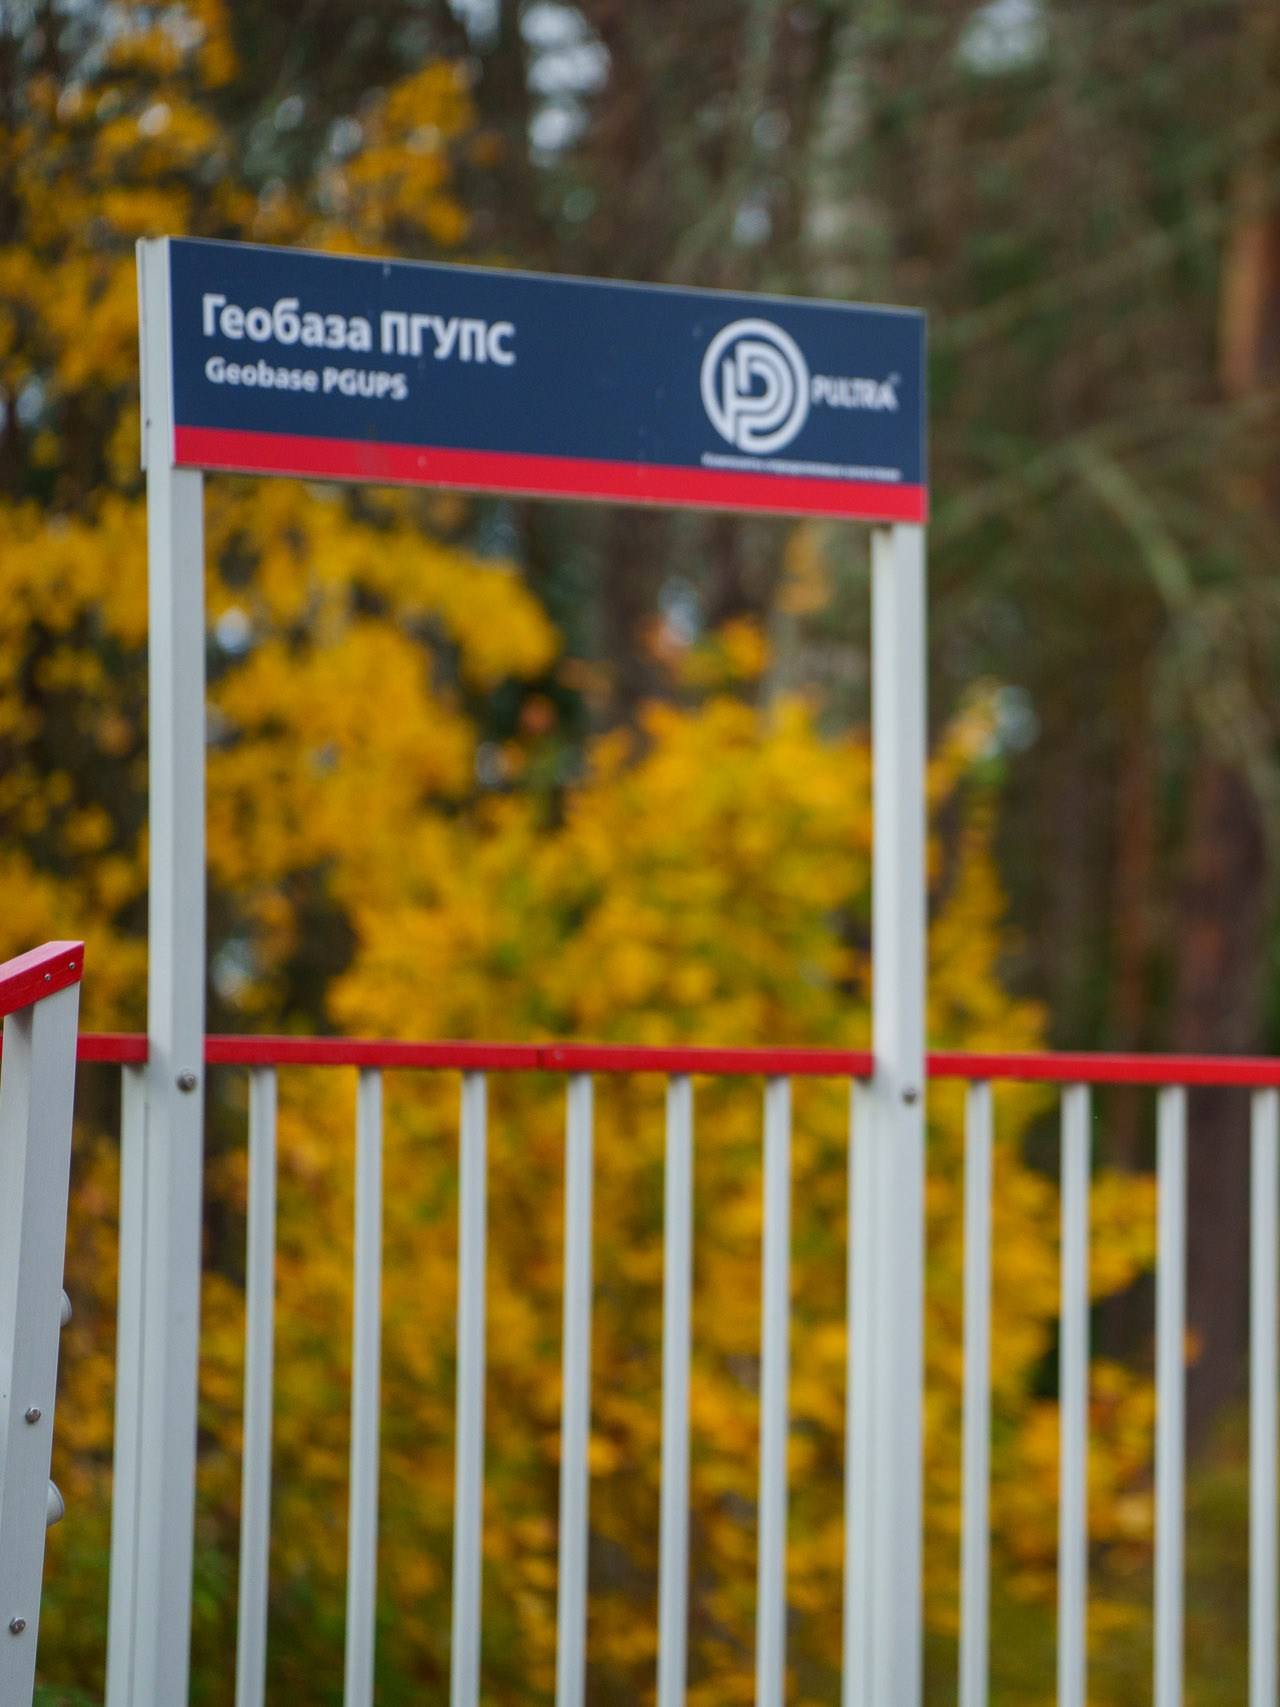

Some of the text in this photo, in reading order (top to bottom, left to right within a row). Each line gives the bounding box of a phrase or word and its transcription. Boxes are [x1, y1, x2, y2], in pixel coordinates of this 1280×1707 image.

[203, 292, 516, 367] Геобаза ПГУПС
[205, 356, 408, 400] Geobase PGUPS
